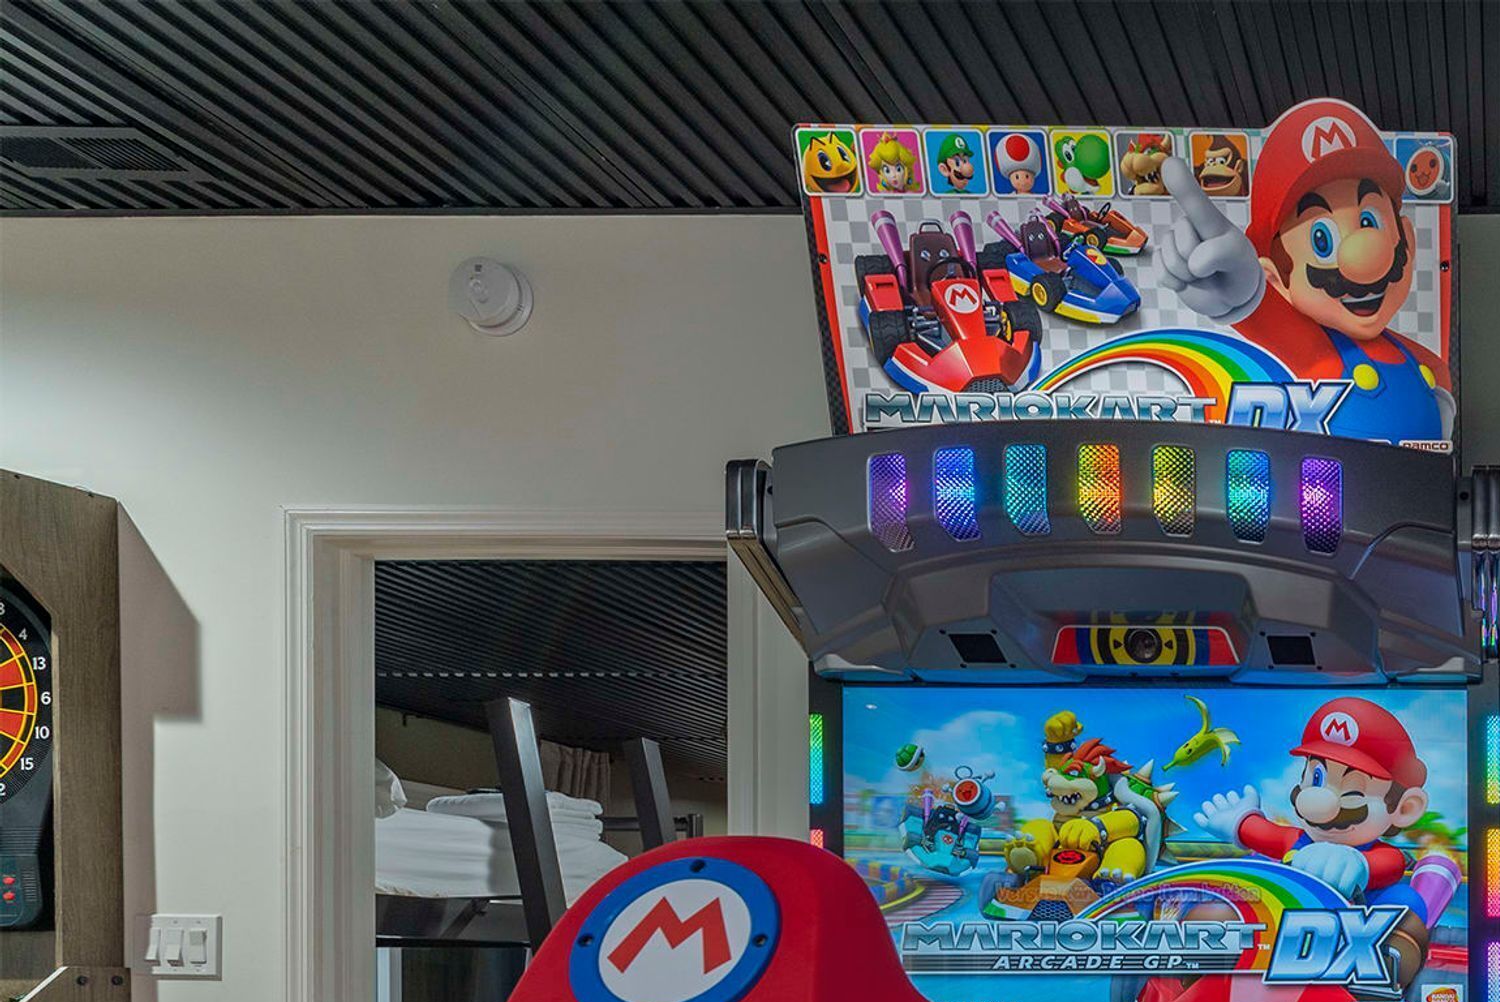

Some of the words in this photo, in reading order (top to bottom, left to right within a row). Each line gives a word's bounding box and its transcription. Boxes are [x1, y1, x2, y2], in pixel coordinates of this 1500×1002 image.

[1310, 121, 1353, 160] M
[949, 287, 977, 307] M
[18, 627, 28, 640] 4
[32, 656, 47, 670] 13
[41, 691, 52, 705] 6
[35, 725, 50, 739] 10
[1325, 718, 1350, 741] M
[20, 757, 34, 771] 15
[607, 896, 732, 974] M
[1267, 906, 1406, 983] DX
[993, 956, 1126, 970] ARCADE
